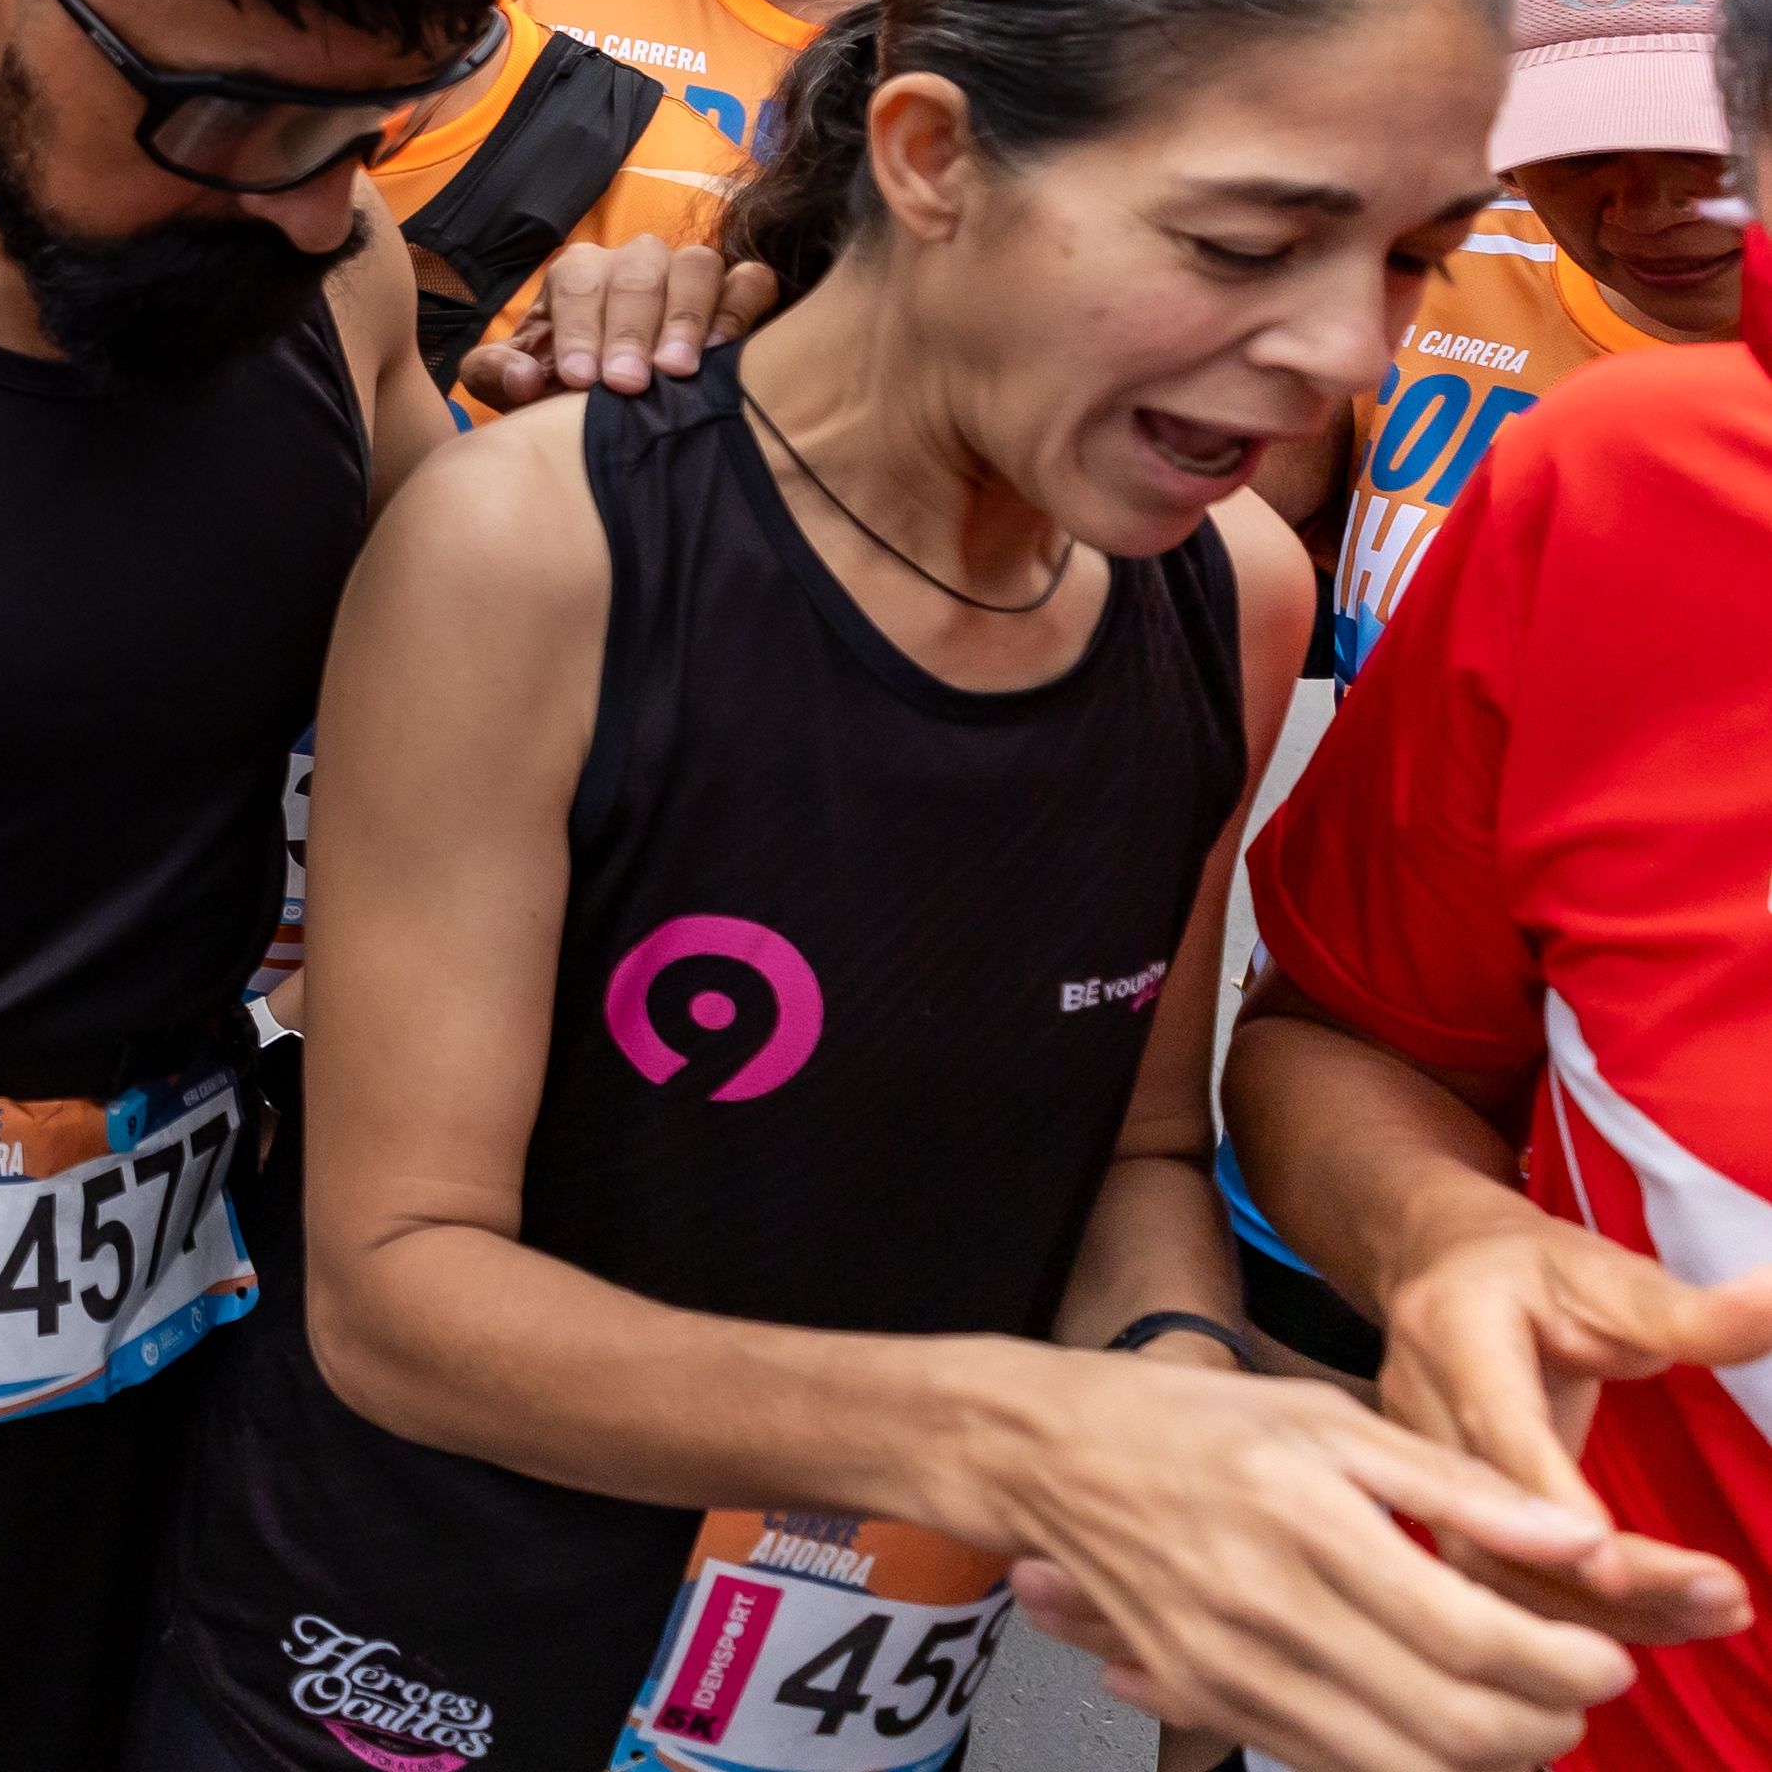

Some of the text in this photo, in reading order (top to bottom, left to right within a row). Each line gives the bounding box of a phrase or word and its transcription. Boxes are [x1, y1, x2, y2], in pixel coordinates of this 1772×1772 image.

[602, 32, 708, 75] CARRERA
[1417, 329, 1531, 374] CARRERA
[1061, 976, 1101, 1013] BE
[747, 1530, 877, 1588] AHORRA
